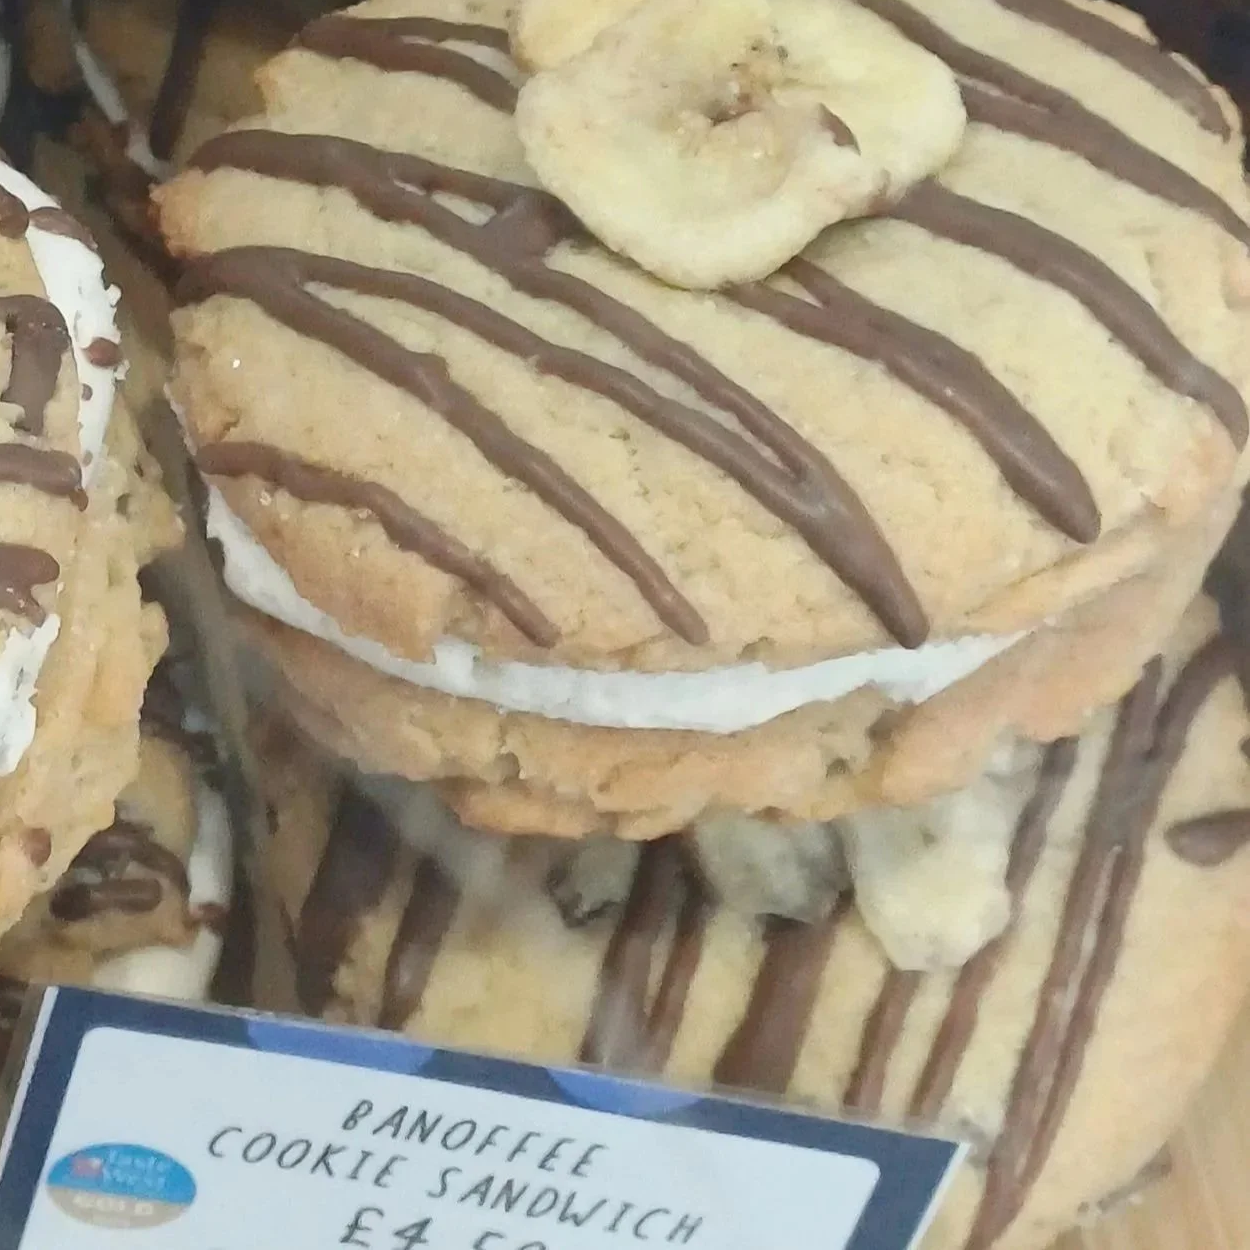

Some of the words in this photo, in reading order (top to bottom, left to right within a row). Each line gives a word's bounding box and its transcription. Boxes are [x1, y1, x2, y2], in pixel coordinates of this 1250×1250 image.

[208, 1126, 409, 1188] COOKIE
[427, 1166, 705, 1245] SANDWICH
[342, 1099, 609, 1178] BANOFFEE
